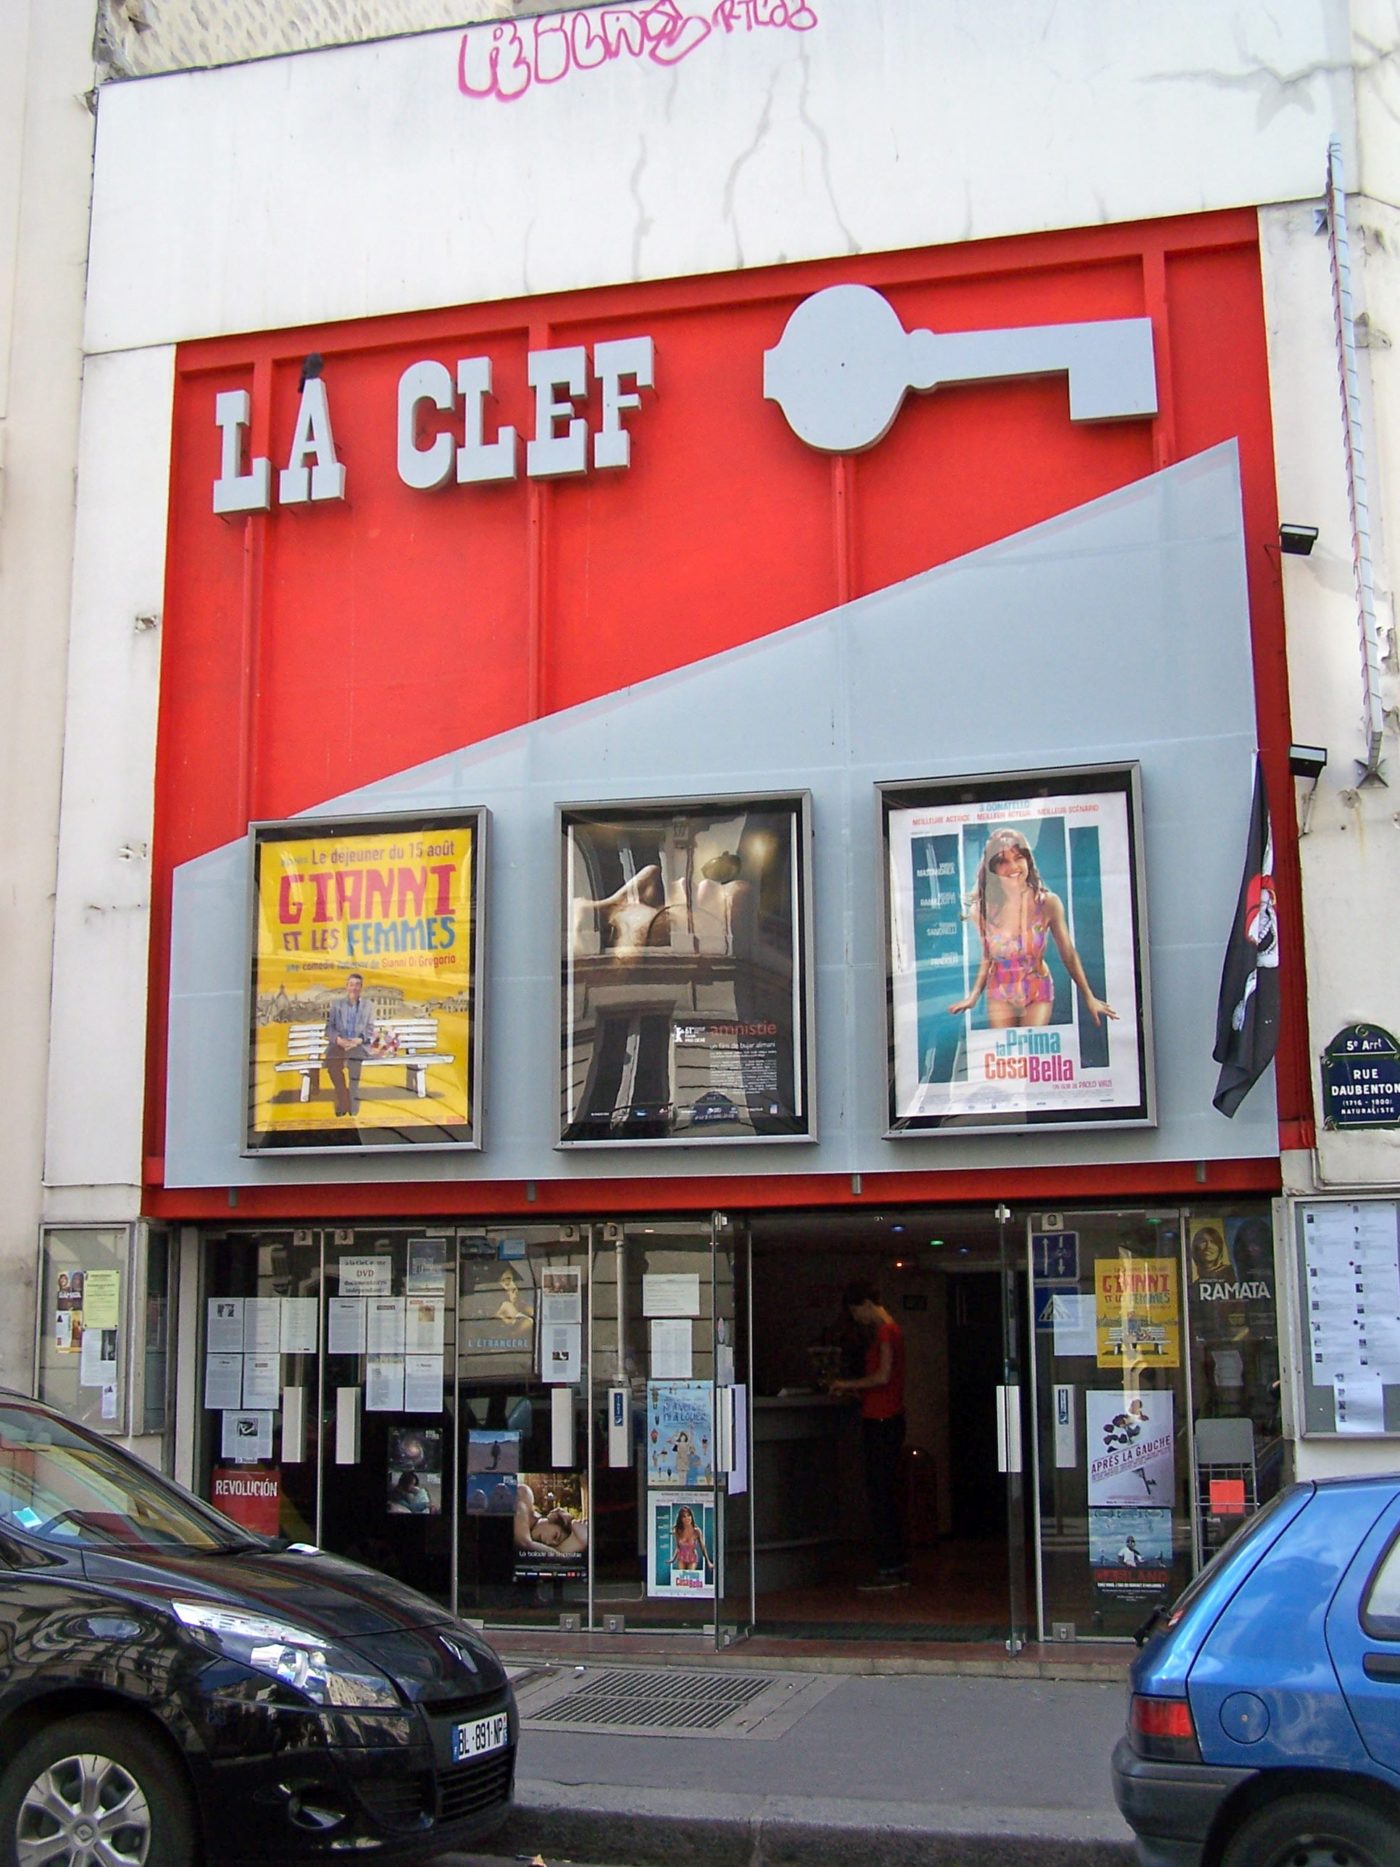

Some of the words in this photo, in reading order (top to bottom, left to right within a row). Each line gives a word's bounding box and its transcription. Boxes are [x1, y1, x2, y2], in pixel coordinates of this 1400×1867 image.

[213, 378, 347, 514] LA
[397, 335, 655, 491] CLEF
[312, 848, 326, 865] Le
[389, 845, 404, 860] du
[409, 841, 423, 858] 15
[426, 840, 455, 857] août
[279, 863, 457, 925] GIANNI
[283, 931, 302, 951] ET
[311, 929, 340, 951] LES
[347, 916, 457, 957] FEMMES
[382, 957, 406, 969] Gianni
[408, 956, 417, 967] Di
[418, 954, 456, 968] Gregorio
[710, 1021, 778, 1036] amnistie
[1006, 1028, 1062, 1056] Prima
[1362, 1038, 1382, 1050] Arrt
[985, 1053, 1028, 1081] Cosa
[1029, 1055, 1074, 1083] Bella
[1353, 1068, 1379, 1080] RUE
[1331, 1083, 1400, 1096] DAUBENTON
[1341, 1107, 1395, 1115] NATURALISTE
[357, 1270, 374, 1278] DVD
[1102, 1274, 1170, 1293] GIANNI
[1199, 1281, 1272, 1301] RAMATA
[1122, 1450, 1133, 1462] LA
[1136, 1435, 1171, 1457] GAUCHE
[216, 1478, 278, 1497] REVOLUCIÓN
